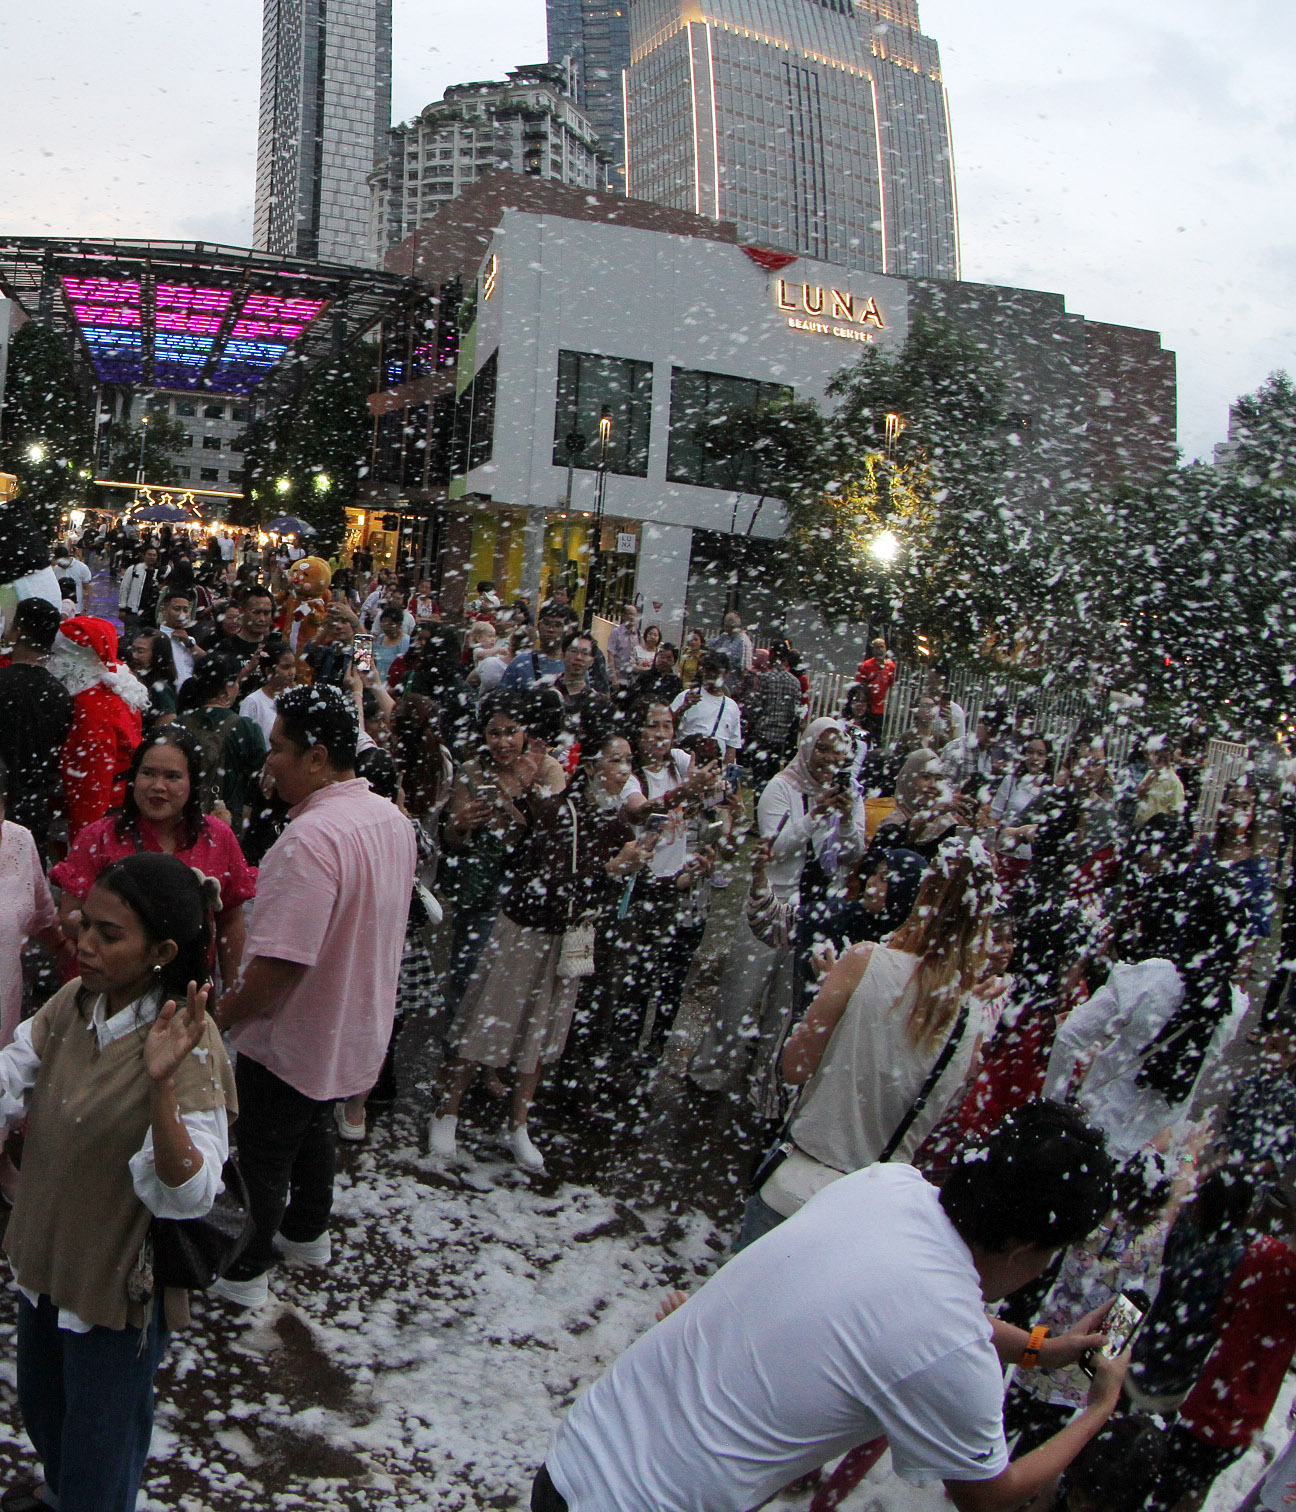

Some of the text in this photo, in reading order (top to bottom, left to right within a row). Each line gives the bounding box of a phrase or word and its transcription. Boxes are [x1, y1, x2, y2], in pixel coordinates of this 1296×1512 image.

[777, 280, 884, 328] LUNA
[788, 318, 874, 342] BEAUTY CENTER
